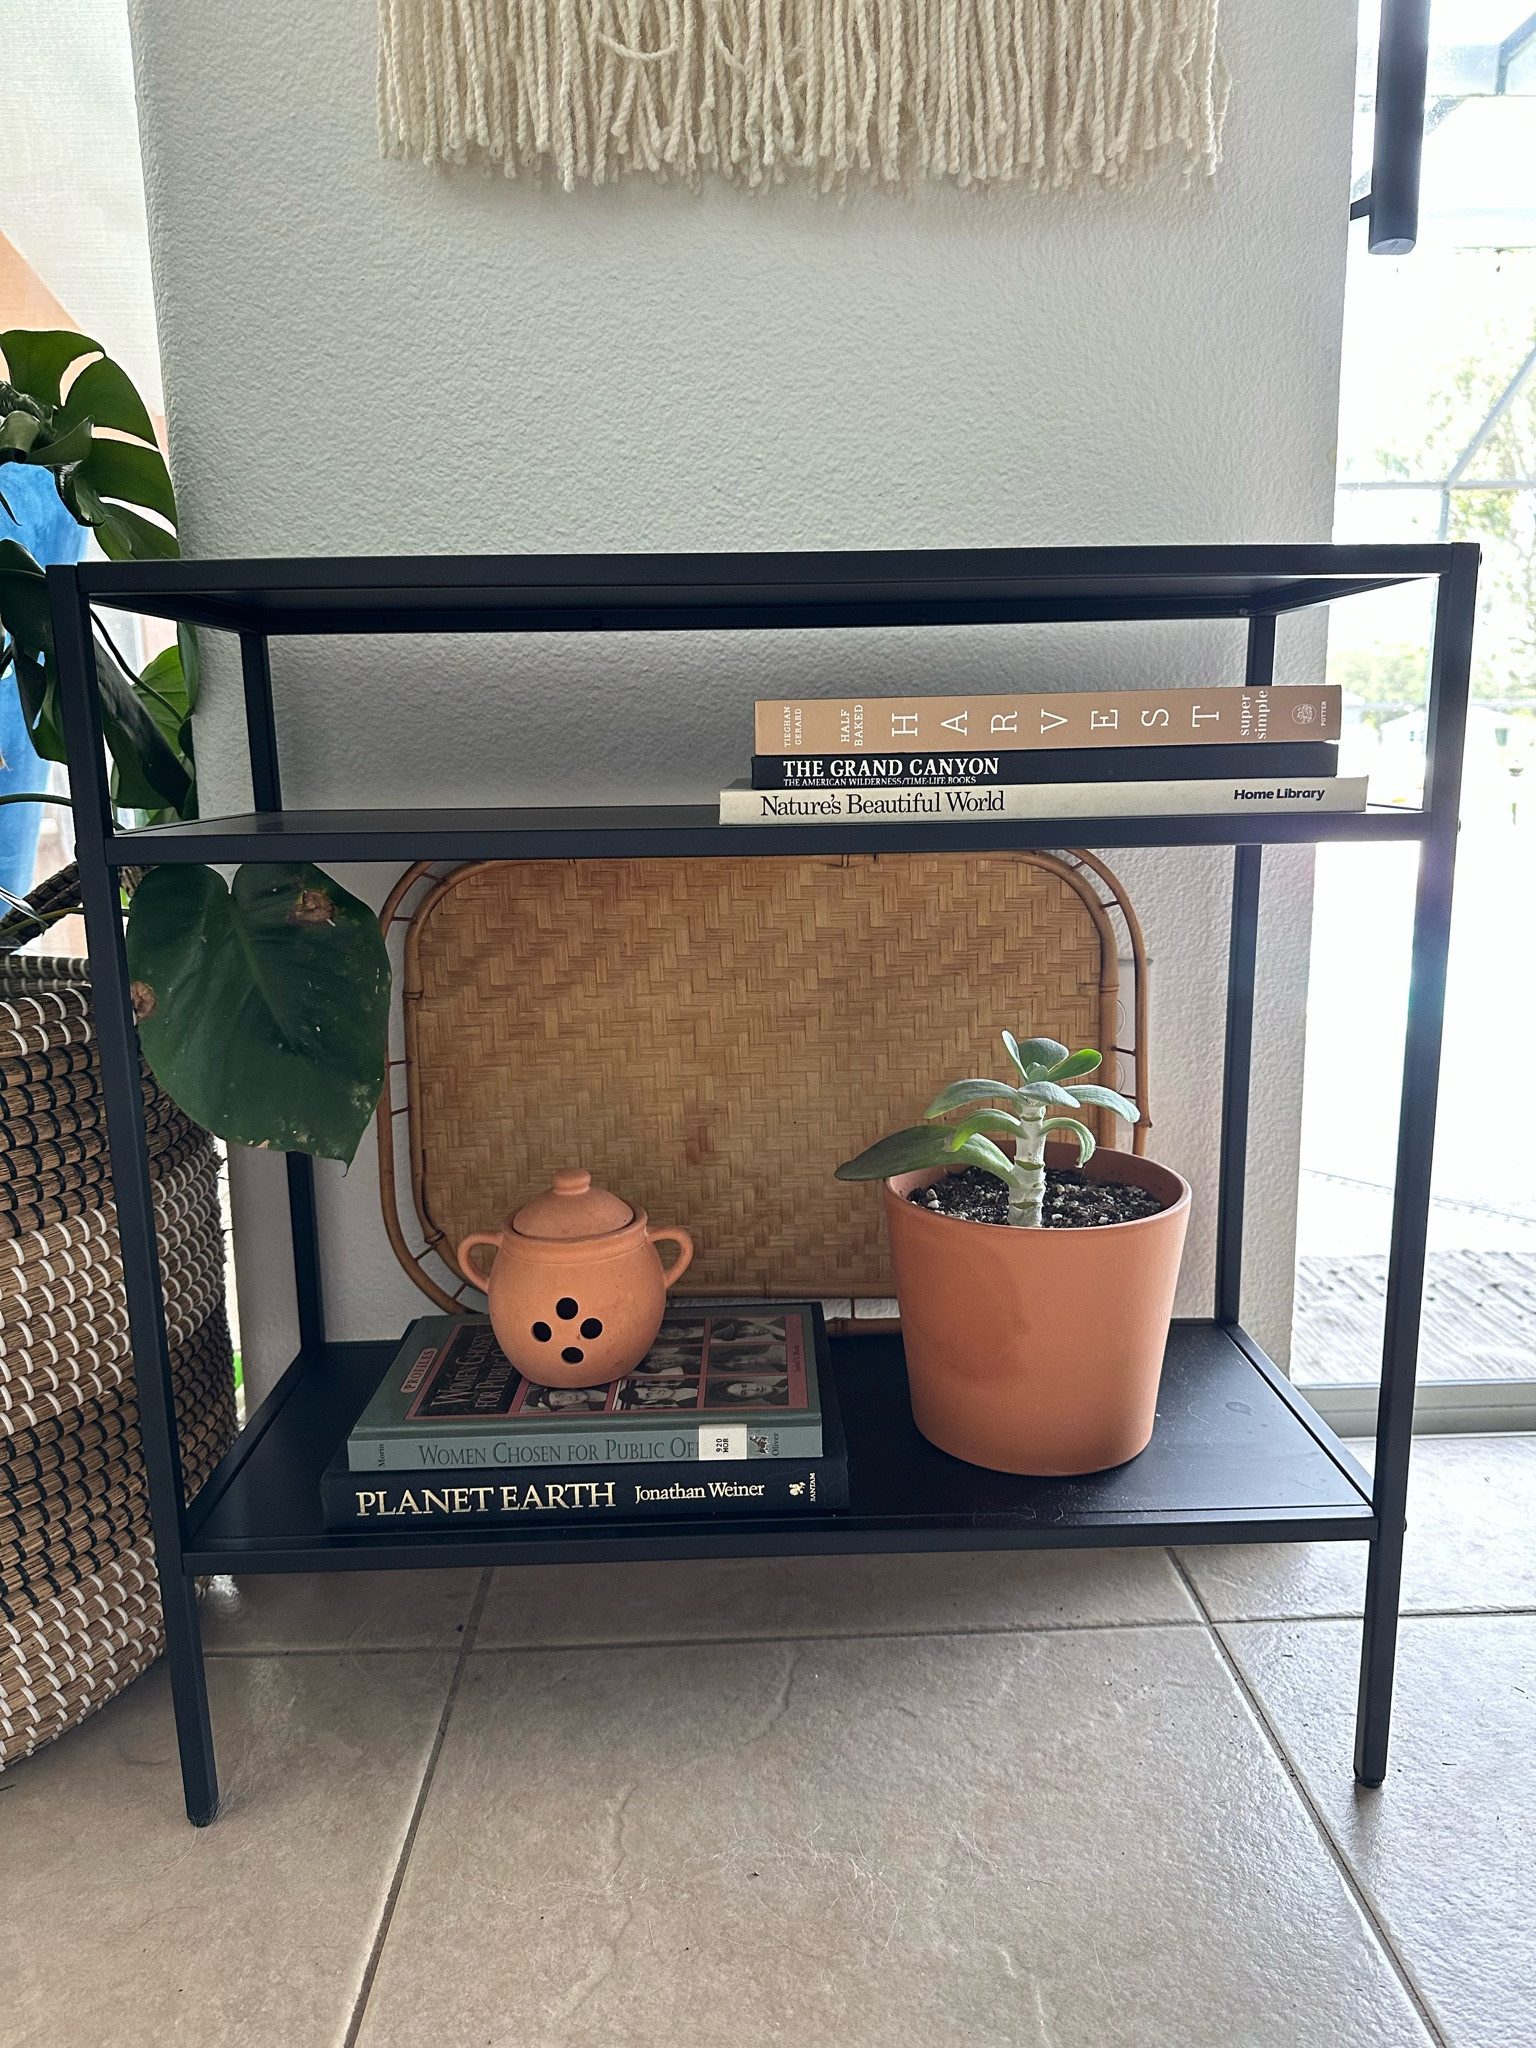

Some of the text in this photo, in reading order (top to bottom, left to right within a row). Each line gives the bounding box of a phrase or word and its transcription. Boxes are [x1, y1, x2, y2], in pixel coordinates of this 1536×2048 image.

[794, 707, 802, 746] GERARD
[840, 708, 850, 743] HALF
[854, 704, 864, 747] BAKED
[891, 705, 1220, 737] HARVEST
[1240, 694, 1251, 736] super
[1254, 689, 1269, 740] simple
[783, 756, 999, 777] THE GRAND CANYON
[783, 779, 800, 787] THE
[801, 778, 847, 787] AMERICAN
[948, 776, 977, 785] BOOKS
[1234, 786, 1326, 802] Home Library
[760, 790, 1005, 816] Nature's Beautiful World
[403, 1350, 436, 1390] PROFILES
[475, 1390, 503, 1408] FOR
[377, 1443, 386, 1468] Morin
[418, 1444, 487, 1466] WOMEN
[493, 1442, 561, 1464] CHOSEN
[567, 1444, 600, 1462] FOR
[605, 1438, 665, 1461] PUBLIC
[715, 1438, 723, 1453] 920
[771, 1432, 779, 1456] Oliver
[356, 1481, 617, 1517] PLANET EARTH
[634, 1481, 765, 1504] Jonathan Weiner
